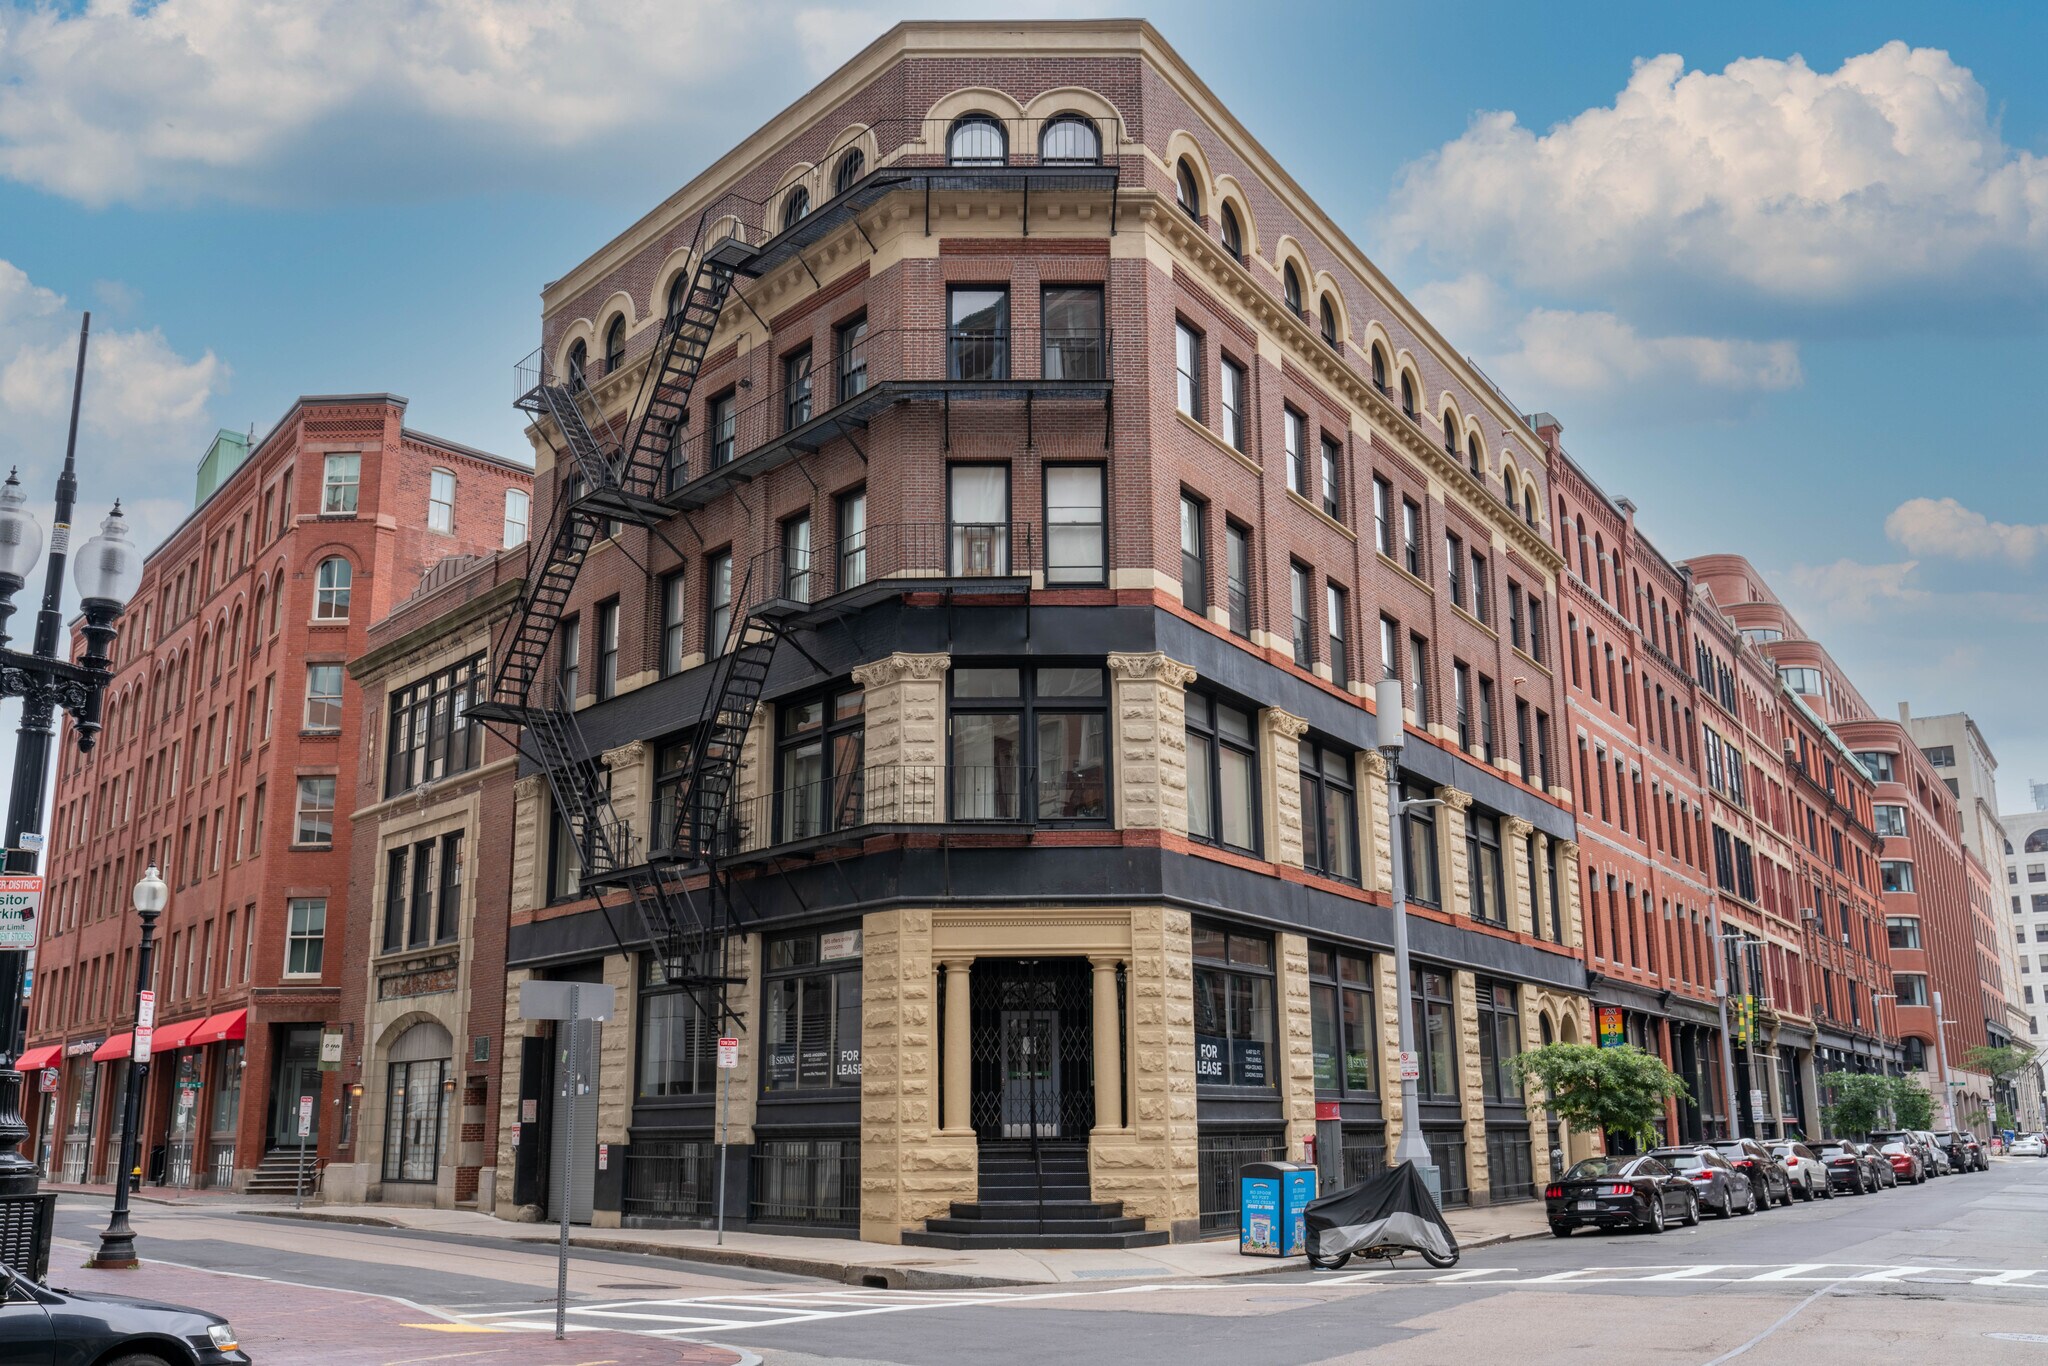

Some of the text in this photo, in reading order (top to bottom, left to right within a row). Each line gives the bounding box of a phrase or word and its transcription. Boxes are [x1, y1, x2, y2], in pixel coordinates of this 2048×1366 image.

[8, 880, 40, 890] DISTRICT
[12, 932, 33, 941] STICKERS
[841, 1050, 859, 1061] FOR
[1200, 1044, 1218, 1058] FOR
[836, 1064, 862, 1075] LEASE
[1197, 1060, 1222, 1075] LEASE
